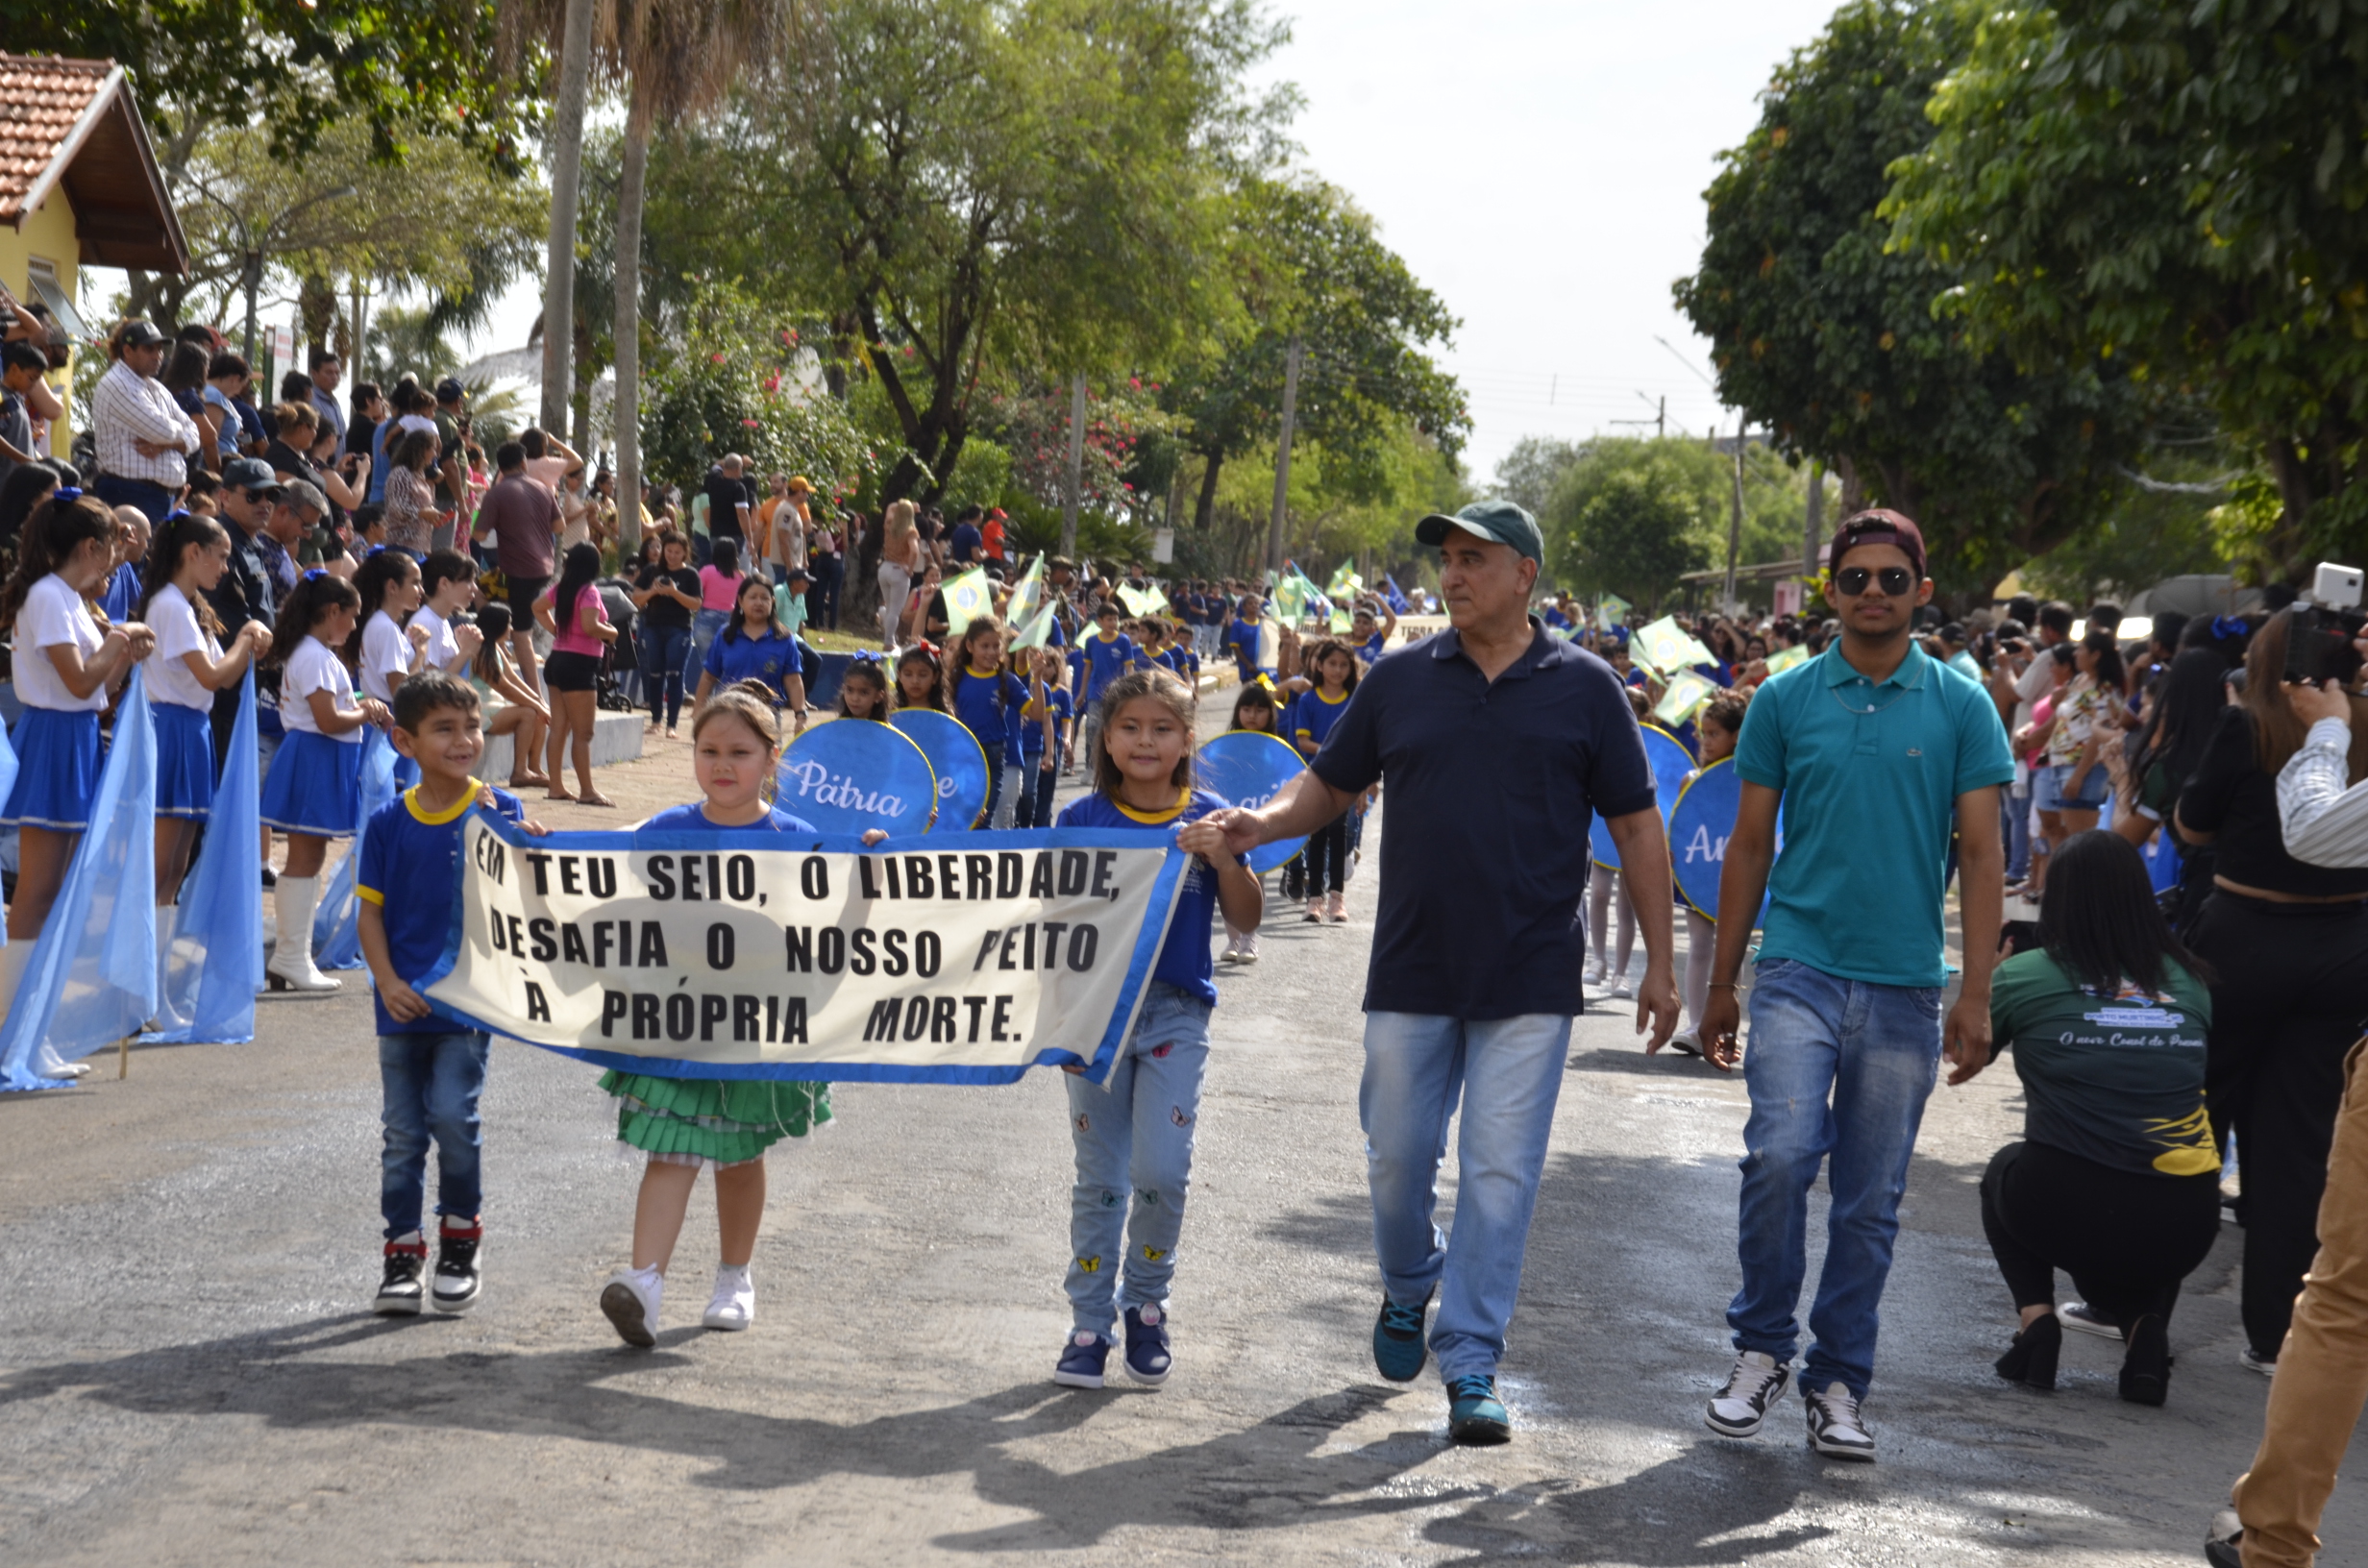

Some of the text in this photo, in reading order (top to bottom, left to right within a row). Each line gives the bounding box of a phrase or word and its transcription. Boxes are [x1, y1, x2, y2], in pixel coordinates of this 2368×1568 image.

[477, 827, 505, 886] EM
[526, 853, 617, 898] TEU
[647, 854, 767, 907] SEIO,
[802, 842, 829, 900] Ó
[858, 850, 1121, 902] LIBERDADE,
[490, 903, 1098, 978] DESAFIA O NOSSO PEITO
[519, 966, 1022, 1044] À PRÓPRIA MORTE.
[2060, 1032, 2074, 1045] O
